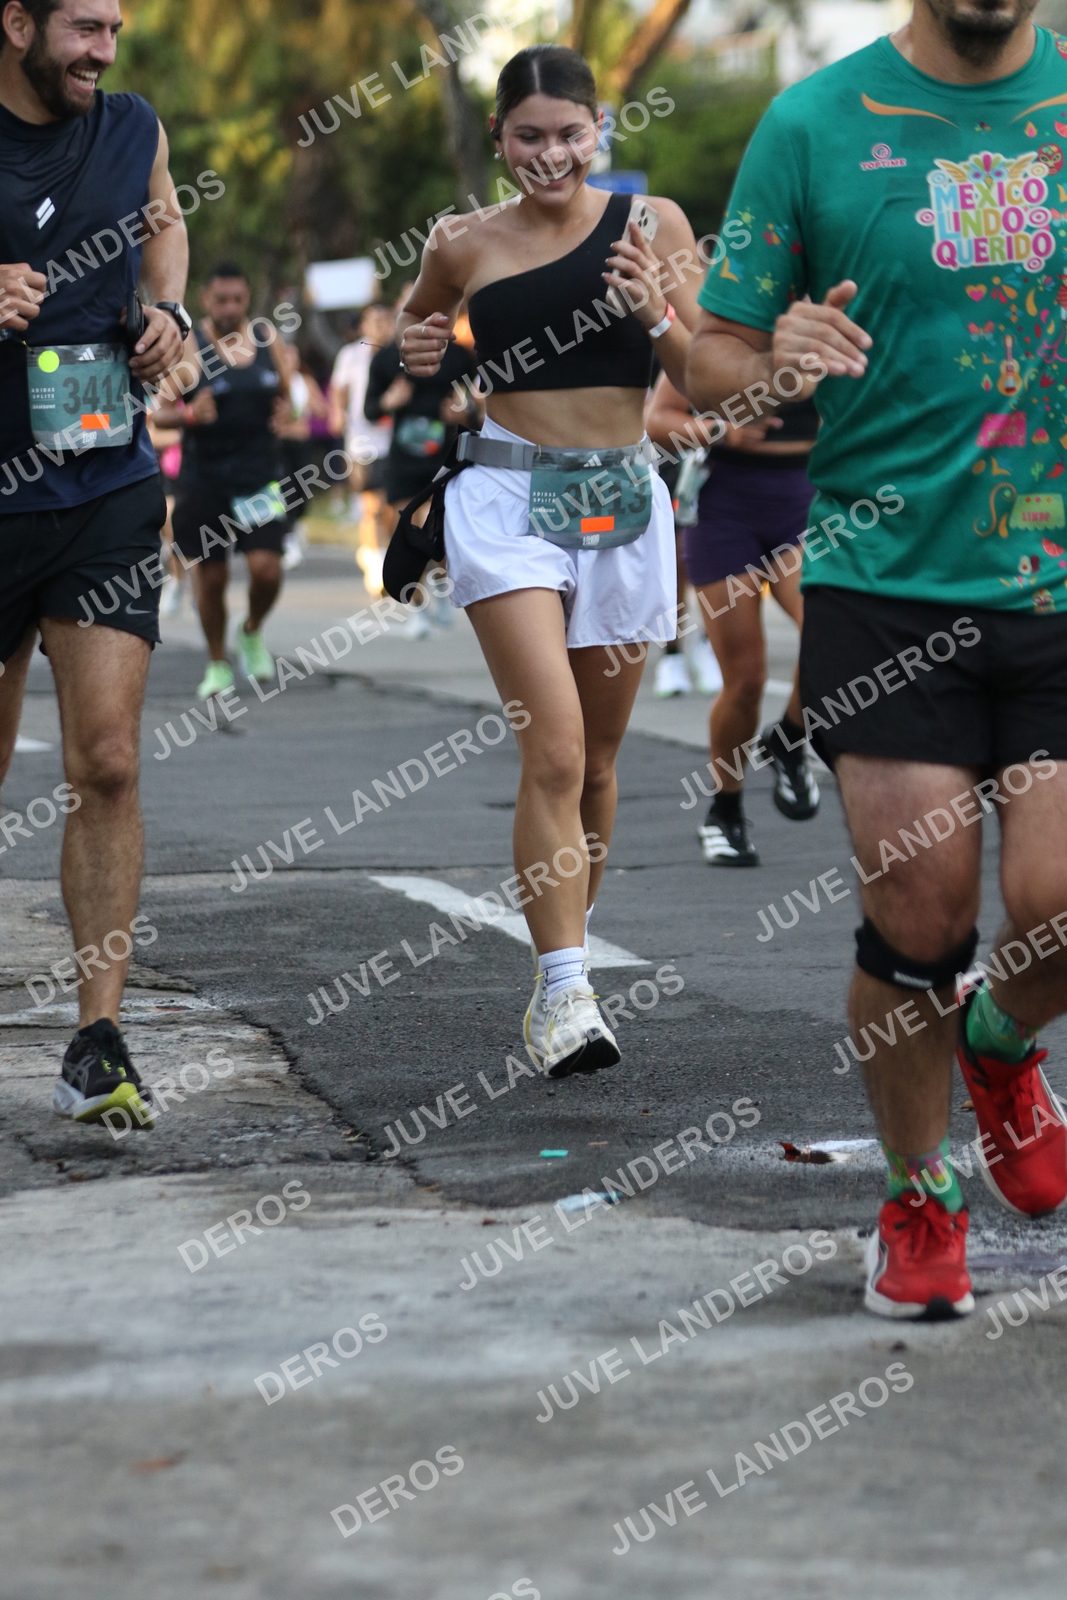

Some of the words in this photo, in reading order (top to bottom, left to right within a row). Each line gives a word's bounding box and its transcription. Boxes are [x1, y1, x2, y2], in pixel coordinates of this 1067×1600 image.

[935, 177, 1045, 213] MEXICO
[936, 206, 1025, 239] LINDO
[936, 229, 1053, 268] QUERIDO
